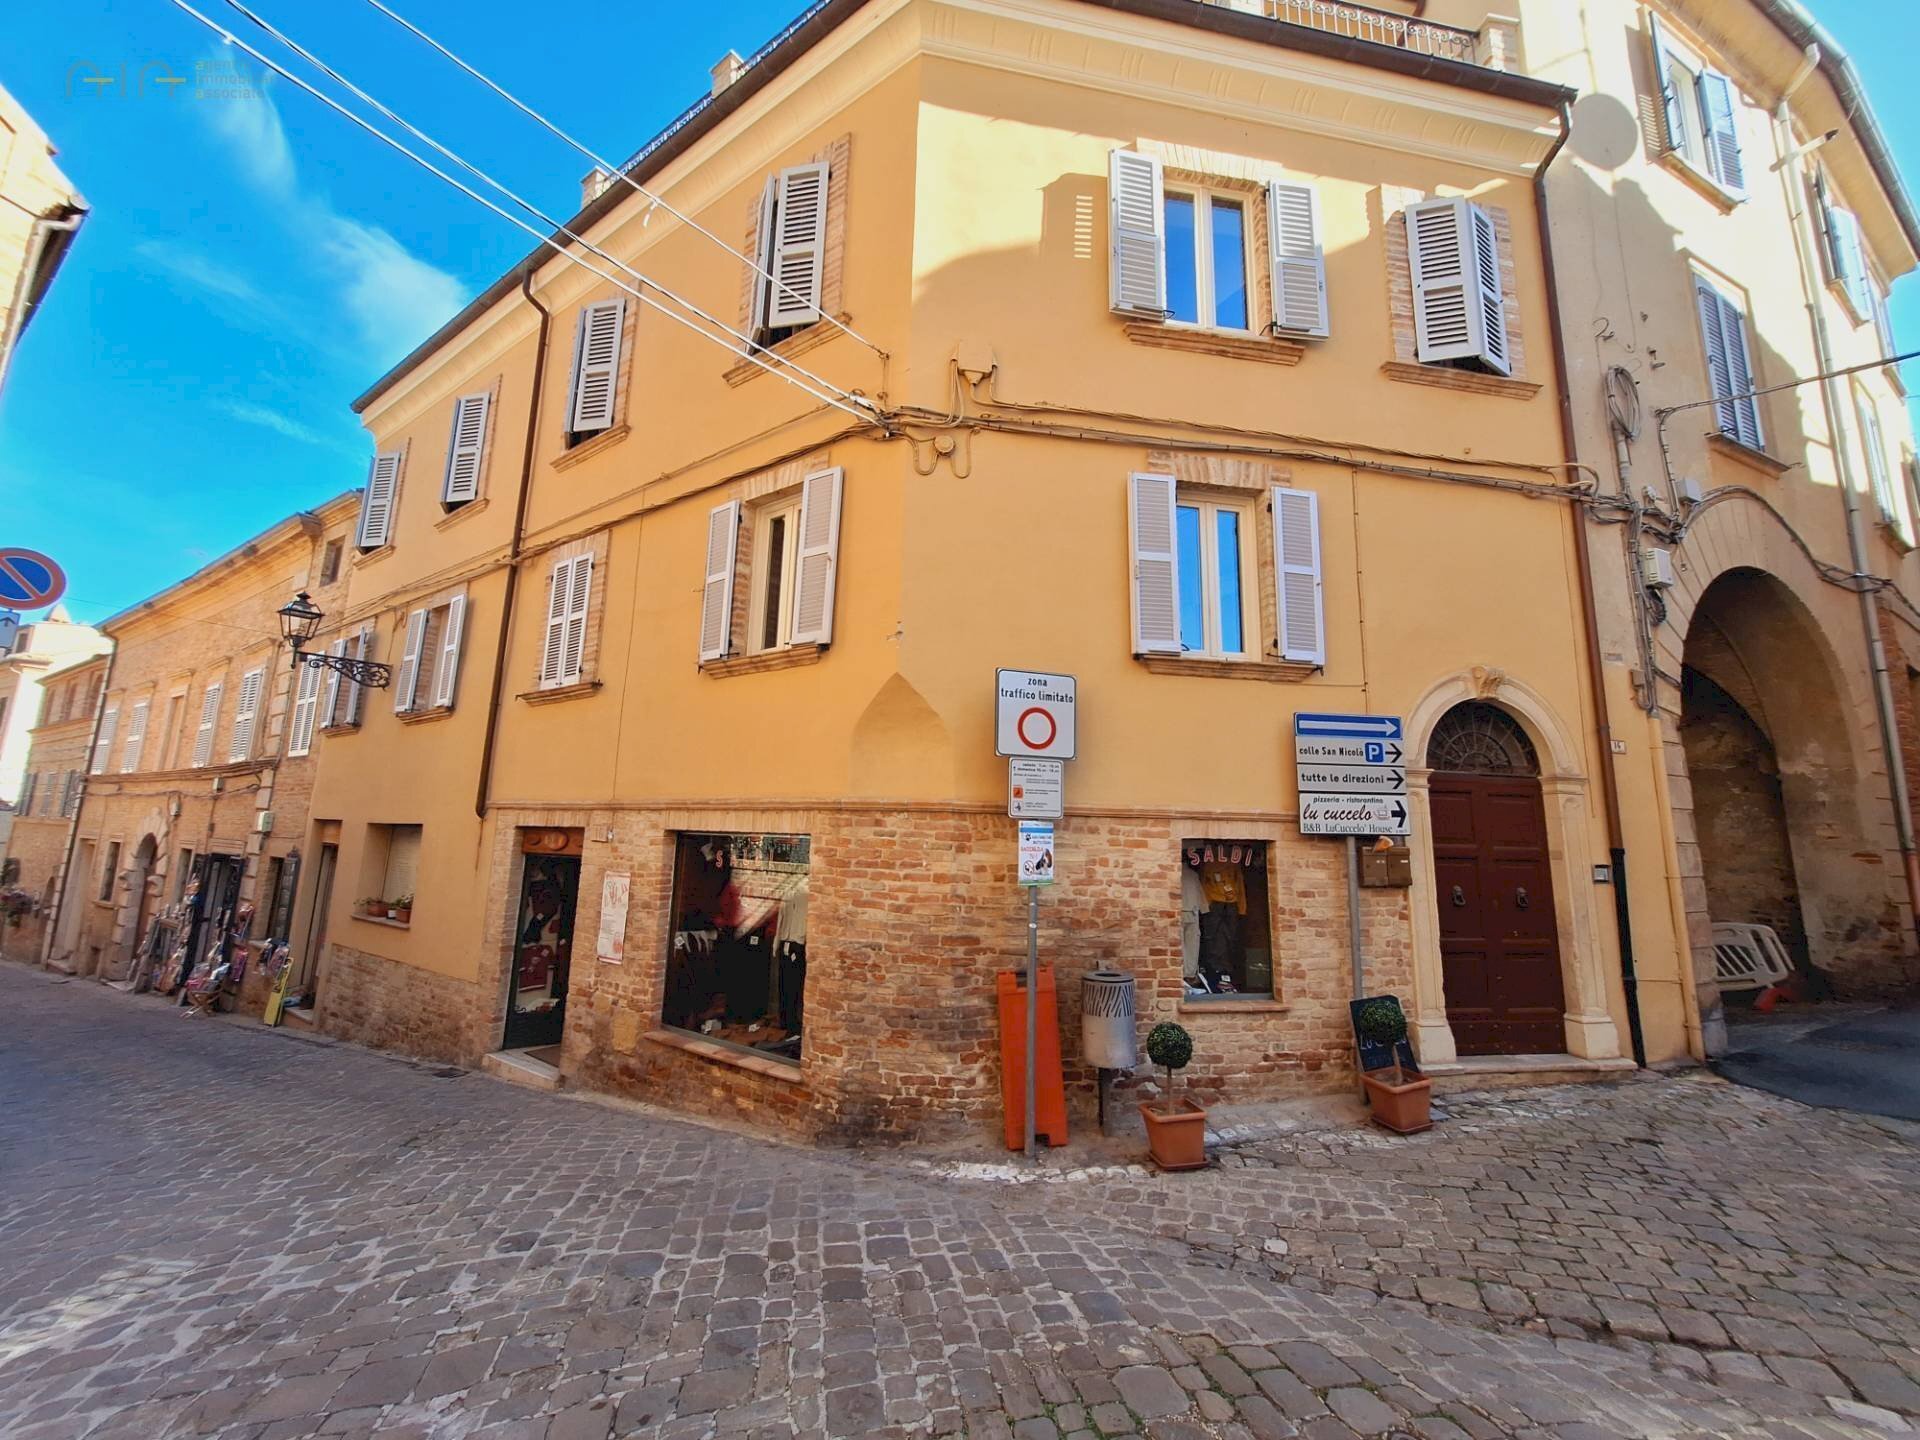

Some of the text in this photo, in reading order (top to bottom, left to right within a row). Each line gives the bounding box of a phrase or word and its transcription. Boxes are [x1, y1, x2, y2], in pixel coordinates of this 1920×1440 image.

[1027, 677, 1048, 687] zona
[1000, 687, 1074, 703] traffico limitato
[1299, 745, 1320, 756] colle
[1322, 746, 1337, 756] San
[1301, 772, 1384, 784] tutte le direzioni
[1312, 795, 1340, 804] pizzeria
[1302, 803, 1373, 821] lu cuccelo
[1303, 823, 1321, 833] B&B
[1369, 824, 1393, 833] House
[1187, 844, 1253, 867] SALDI
